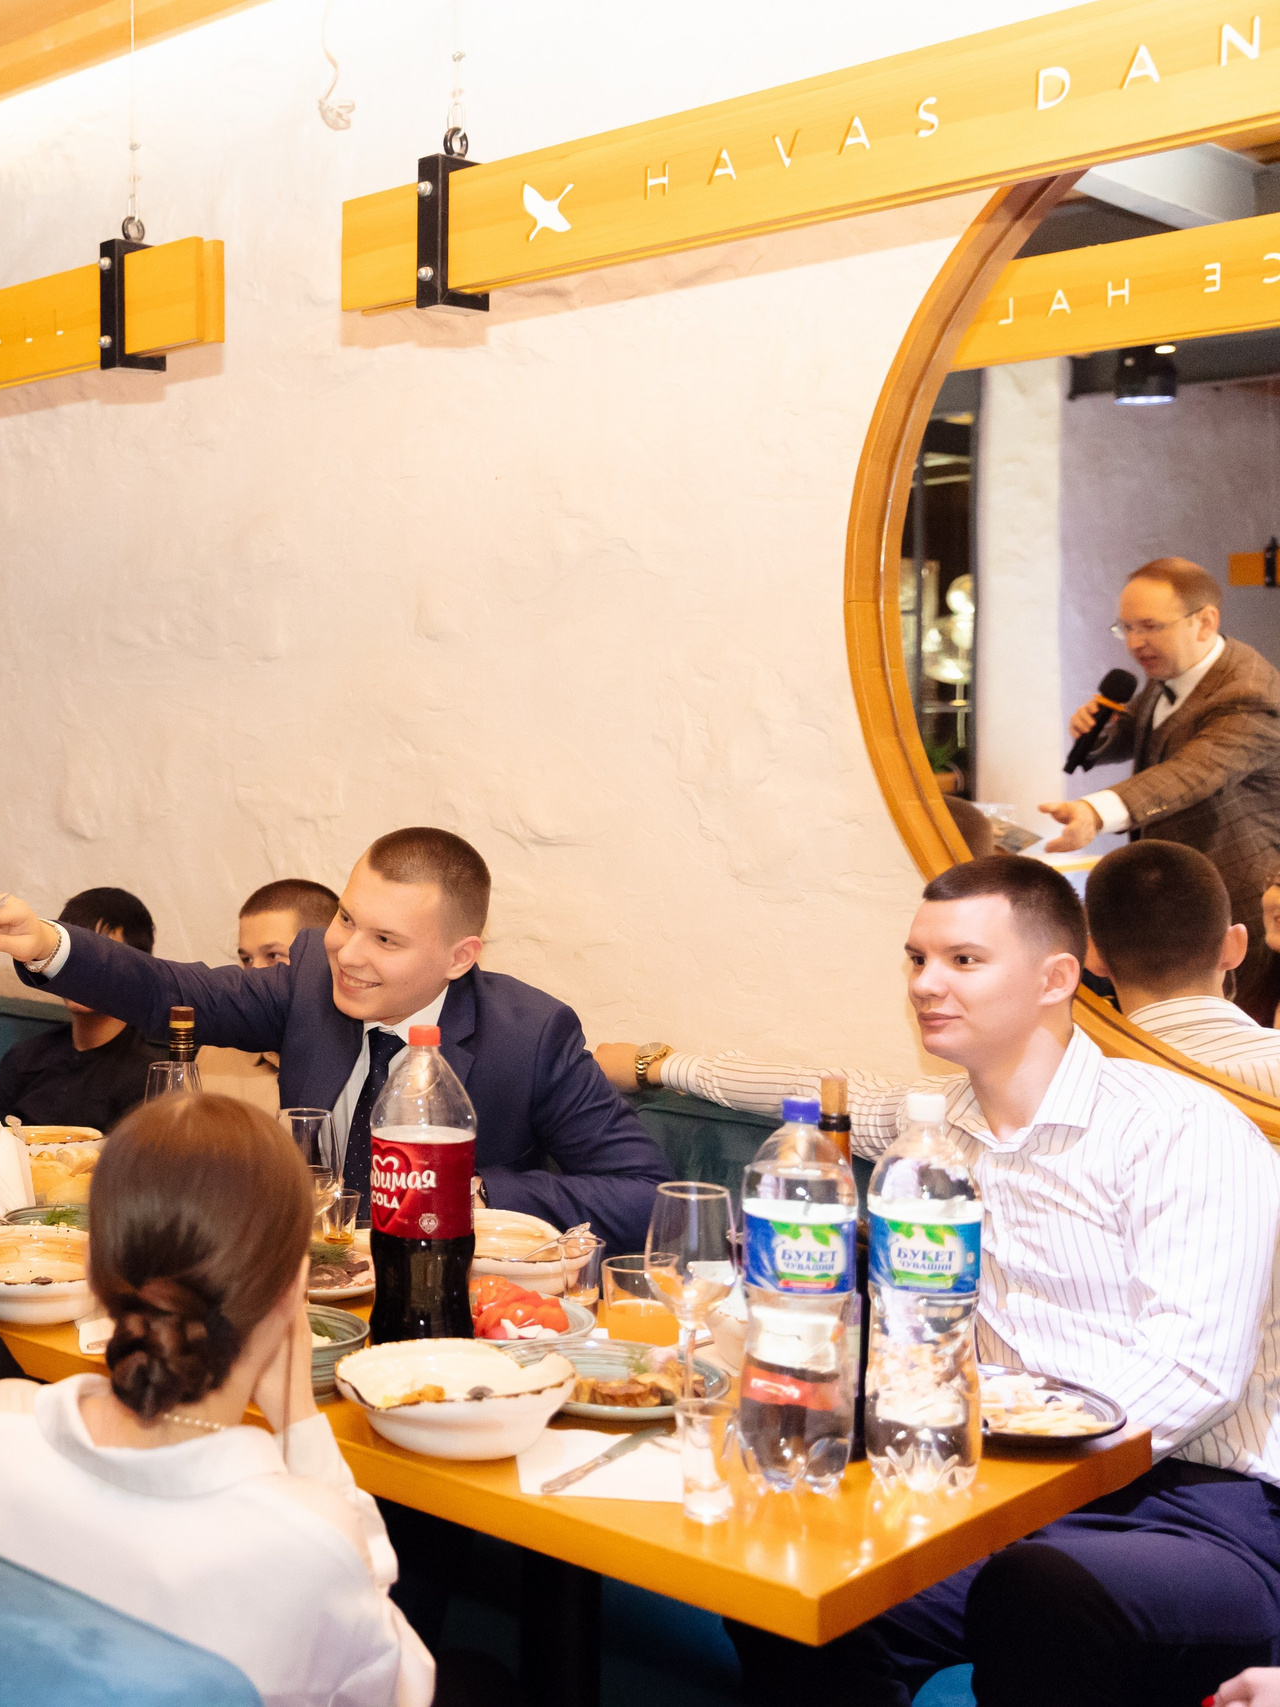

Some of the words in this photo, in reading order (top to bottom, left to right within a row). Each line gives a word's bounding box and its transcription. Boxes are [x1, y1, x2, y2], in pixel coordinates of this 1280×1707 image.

[644, 96, 939, 200] HAVAS
[1035, 15, 1261, 110] DAN
[371, 1190, 400, 1210] COLA
[781, 1248, 839, 1263] БУКЕТ
[896, 1247, 956, 1263] БУКЕТ
